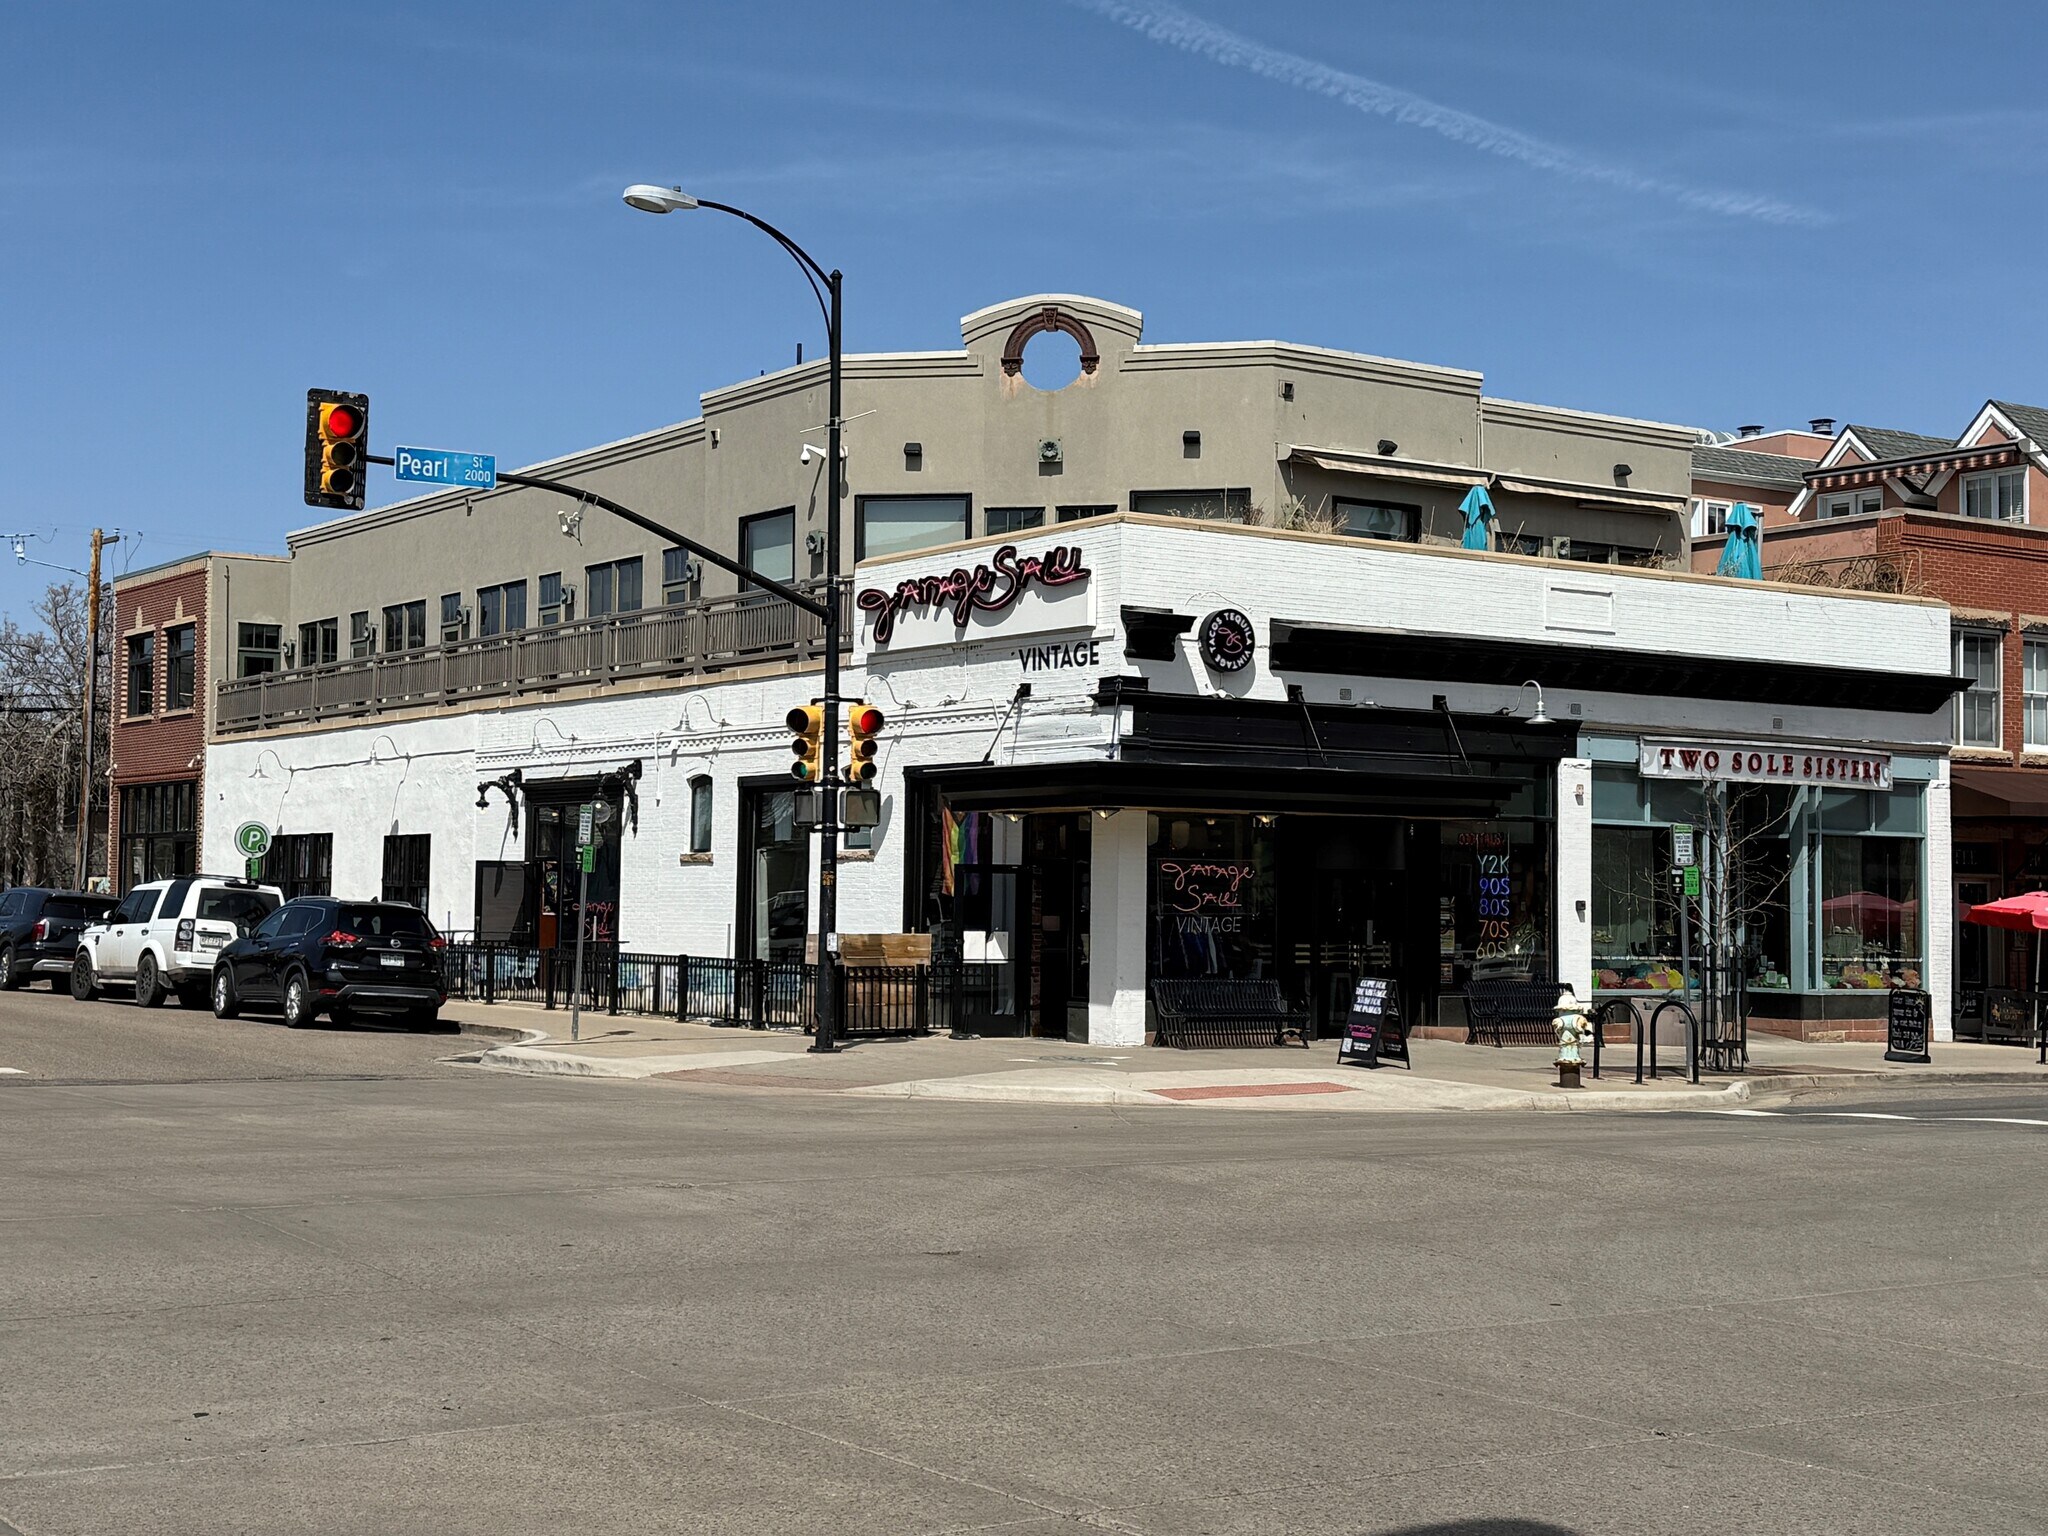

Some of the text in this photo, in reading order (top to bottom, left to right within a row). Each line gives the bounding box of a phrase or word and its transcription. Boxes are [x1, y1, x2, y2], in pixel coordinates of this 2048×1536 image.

[399, 453, 483, 478] Pearl St
[464, 469, 491, 482] 2000
[1208, 612, 1253, 670] TACOS TEQUILA VINTAGE
[1018, 641, 1100, 673] VINTAGE
[1660, 749, 1882, 783] TWO SOLE SISTERS
[1477, 855, 1510, 874] Y2K
[1479, 878, 1510, 895] 90S
[1479, 899, 1510, 916] 80S
[1176, 916, 1242, 933] VINTAGE
[1478, 920, 1510, 938] 70S
[1475, 941, 1507, 959] 60S
